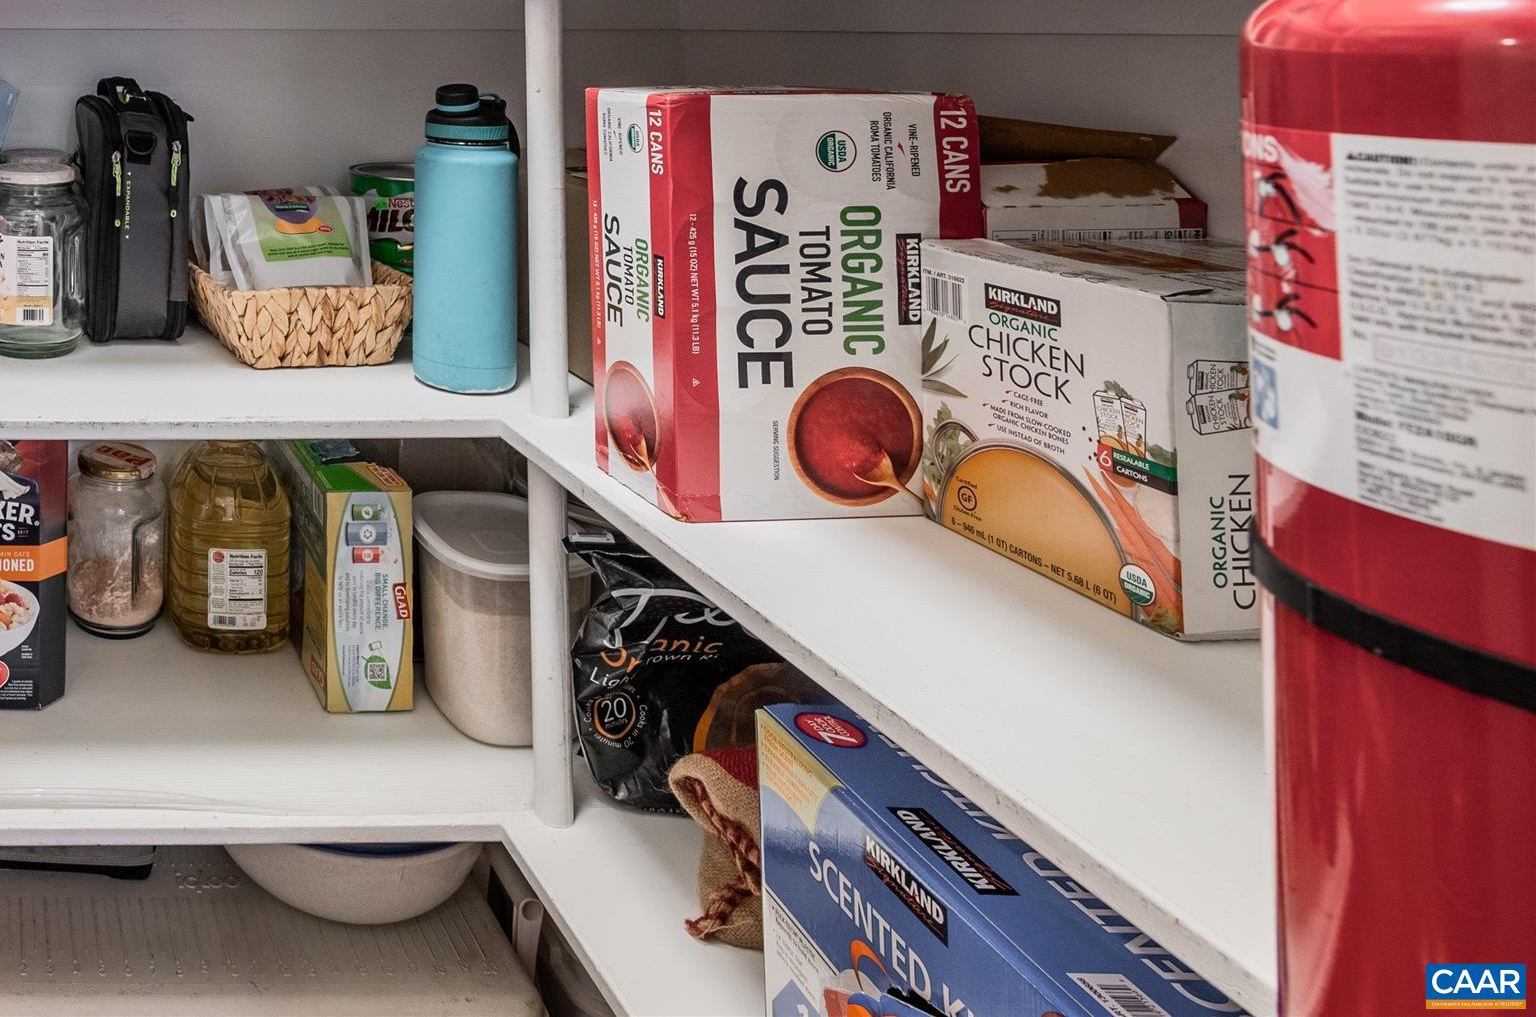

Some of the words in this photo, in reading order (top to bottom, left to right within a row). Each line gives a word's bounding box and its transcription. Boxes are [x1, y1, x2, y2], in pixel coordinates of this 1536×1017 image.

[649, 109, 661, 126] 12
[870, 120, 879, 140] ROMA
[883, 112, 892, 145] ORGANIC
[939, 109, 967, 130] 12
[650, 132, 664, 176] CANS
[827, 137, 835, 167] ORGANIC
[838, 140, 846, 163] USDA
[871, 141, 882, 182] TOMATOES
[908, 123, 921, 177] VINE-RIPENED
[941, 136, 971, 193] CANS
[885, 146, 896, 191] CALIFORNIA
[389, 198, 414, 209] Nest
[605, 214, 623, 327] SAUCE
[624, 246, 634, 305] TOMATO
[635, 238, 649, 322] ORGANIC
[733, 177, 794, 388] SAUCE
[799, 225, 833, 335] TOMATO
[840, 205, 886, 355] ORGANIC
[906, 238, 921, 322] KIRKLAND
[656, 259, 664, 316] KIRKLAND
[988, 287, 1058, 315] KIRKLAND
[989, 312, 1058, 342] ORGANIC
[968, 324, 1085, 378] CHICKEN
[982, 355, 1072, 404] STOCK
[1010, 401, 1023, 411] RICH
[1024, 405, 1048, 419] FLAVOR
[1014, 392, 1044, 407] CAGE-FREE
[990, 405, 1006, 415] MADE
[1007, 409, 1024, 421] FROM
[1025, 415, 1071, 437] SLOW-COOKED
[993, 413, 1019, 428] ORGANIC
[1020, 420, 1047, 436] CHICKEN
[1048, 429, 1069, 445] BONES
[997, 425, 1007, 433] USE
[1008, 428, 1032, 443] INSTEAD
[1034, 437, 1042, 445] OF
[1043, 440, 1065, 454] BROTH
[1100, 450, 1111, 467] 6
[1114, 453, 1149, 470] RESEALABLE
[1116, 465, 1148, 482] CARTONS
[961, 491, 972, 504] GF
[1210, 496, 1228, 588] ORGANIC
[1228, 474, 1256, 610] CHICKEN
[1009, 544, 1042, 567] CARTONS
[1051, 563, 1065, 577] NET
[1124, 582, 1150, 599] ORGANIC
[1127, 571, 1147, 588] USDA
[394, 585, 408, 618] GLAD
[601, 698, 626, 723] 20
[895, 809, 997, 890] KIRKLAND
[866, 835, 944, 924] KIRKLAND
[809, 841, 930, 1002] SCENTED
